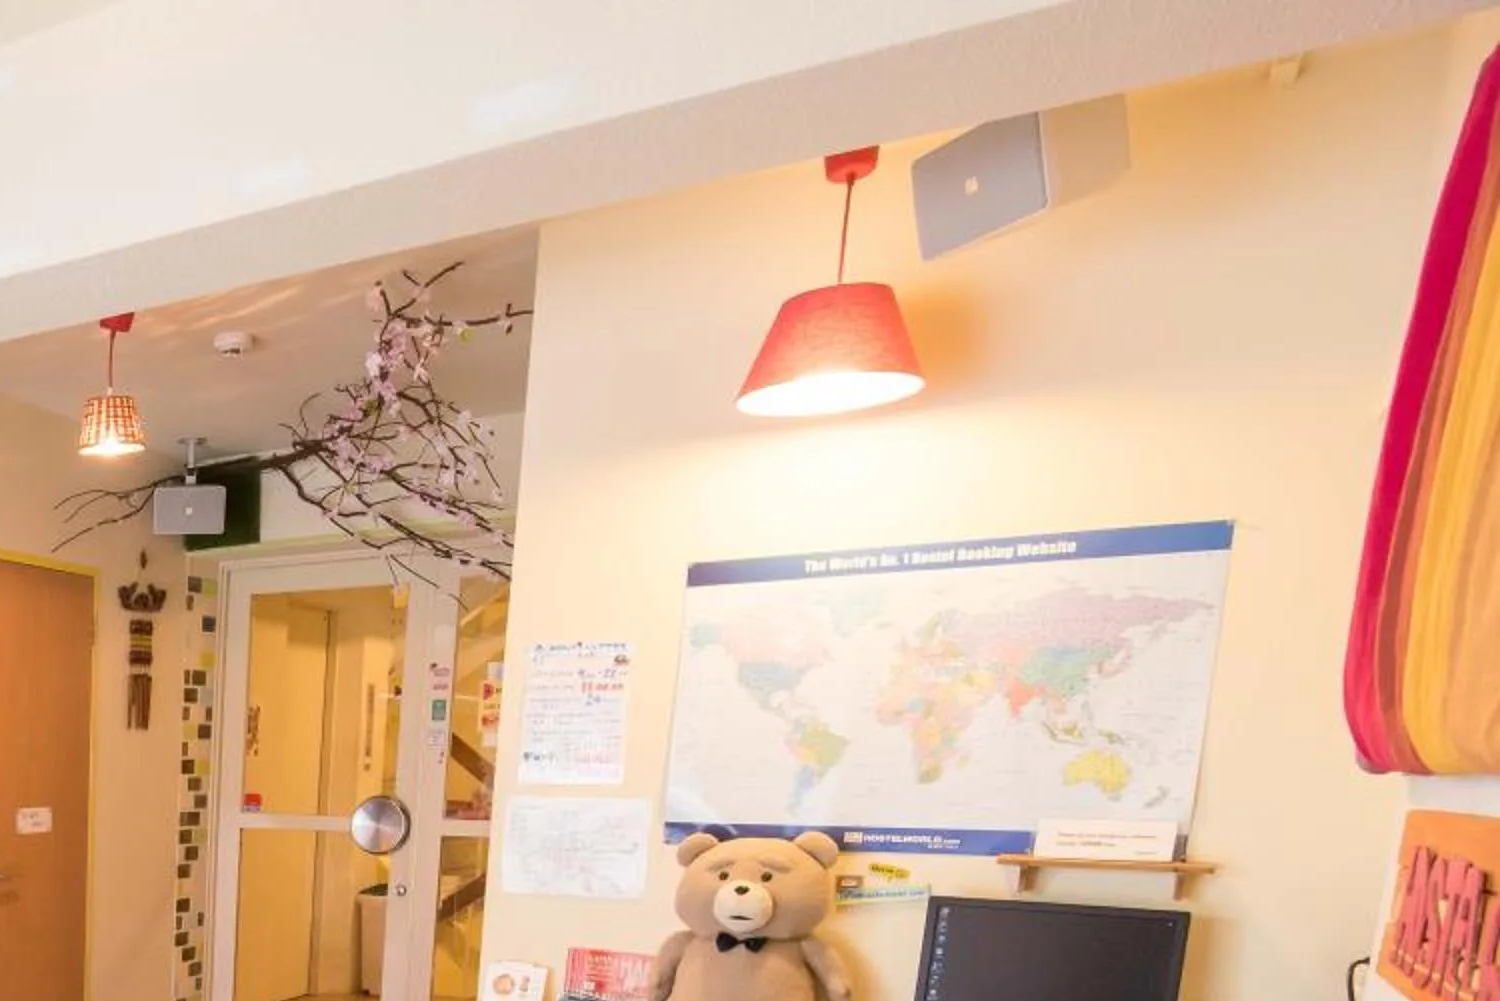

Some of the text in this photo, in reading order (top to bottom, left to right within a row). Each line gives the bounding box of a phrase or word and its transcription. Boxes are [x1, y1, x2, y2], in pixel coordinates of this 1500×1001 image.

[804, 559, 827, 574] The
[829, 556, 877, 572] World's
[957, 546, 1013, 562] Booking
[1017, 540, 1077, 557] Website
